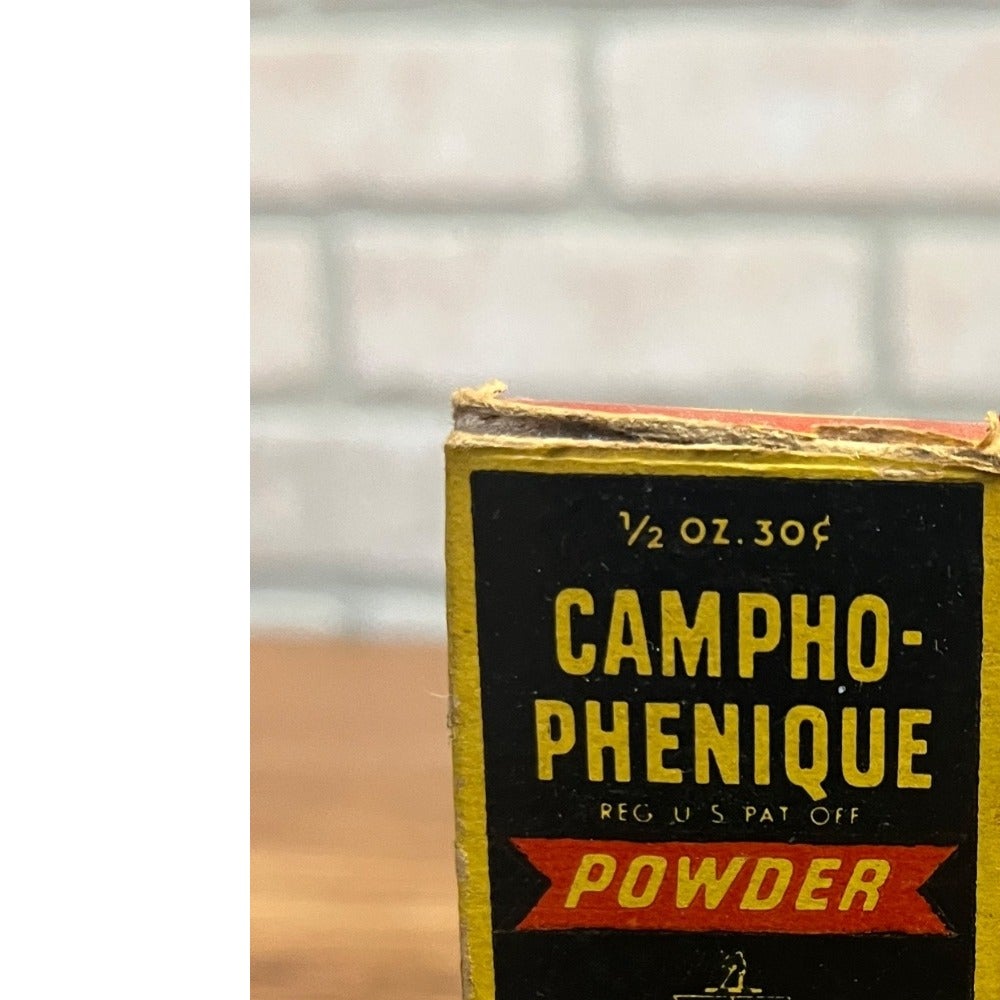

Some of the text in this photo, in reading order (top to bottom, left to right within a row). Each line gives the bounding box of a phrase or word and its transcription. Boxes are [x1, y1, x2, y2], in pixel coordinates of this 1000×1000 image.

[680, 516, 743, 545] OZ.
[554, 587, 922, 683] CAMPHO-
[534, 699, 933, 801] PHENIQUE
[600, 803, 859, 826] REG U S PAT OFF
[563, 853, 891, 913] POWDER
